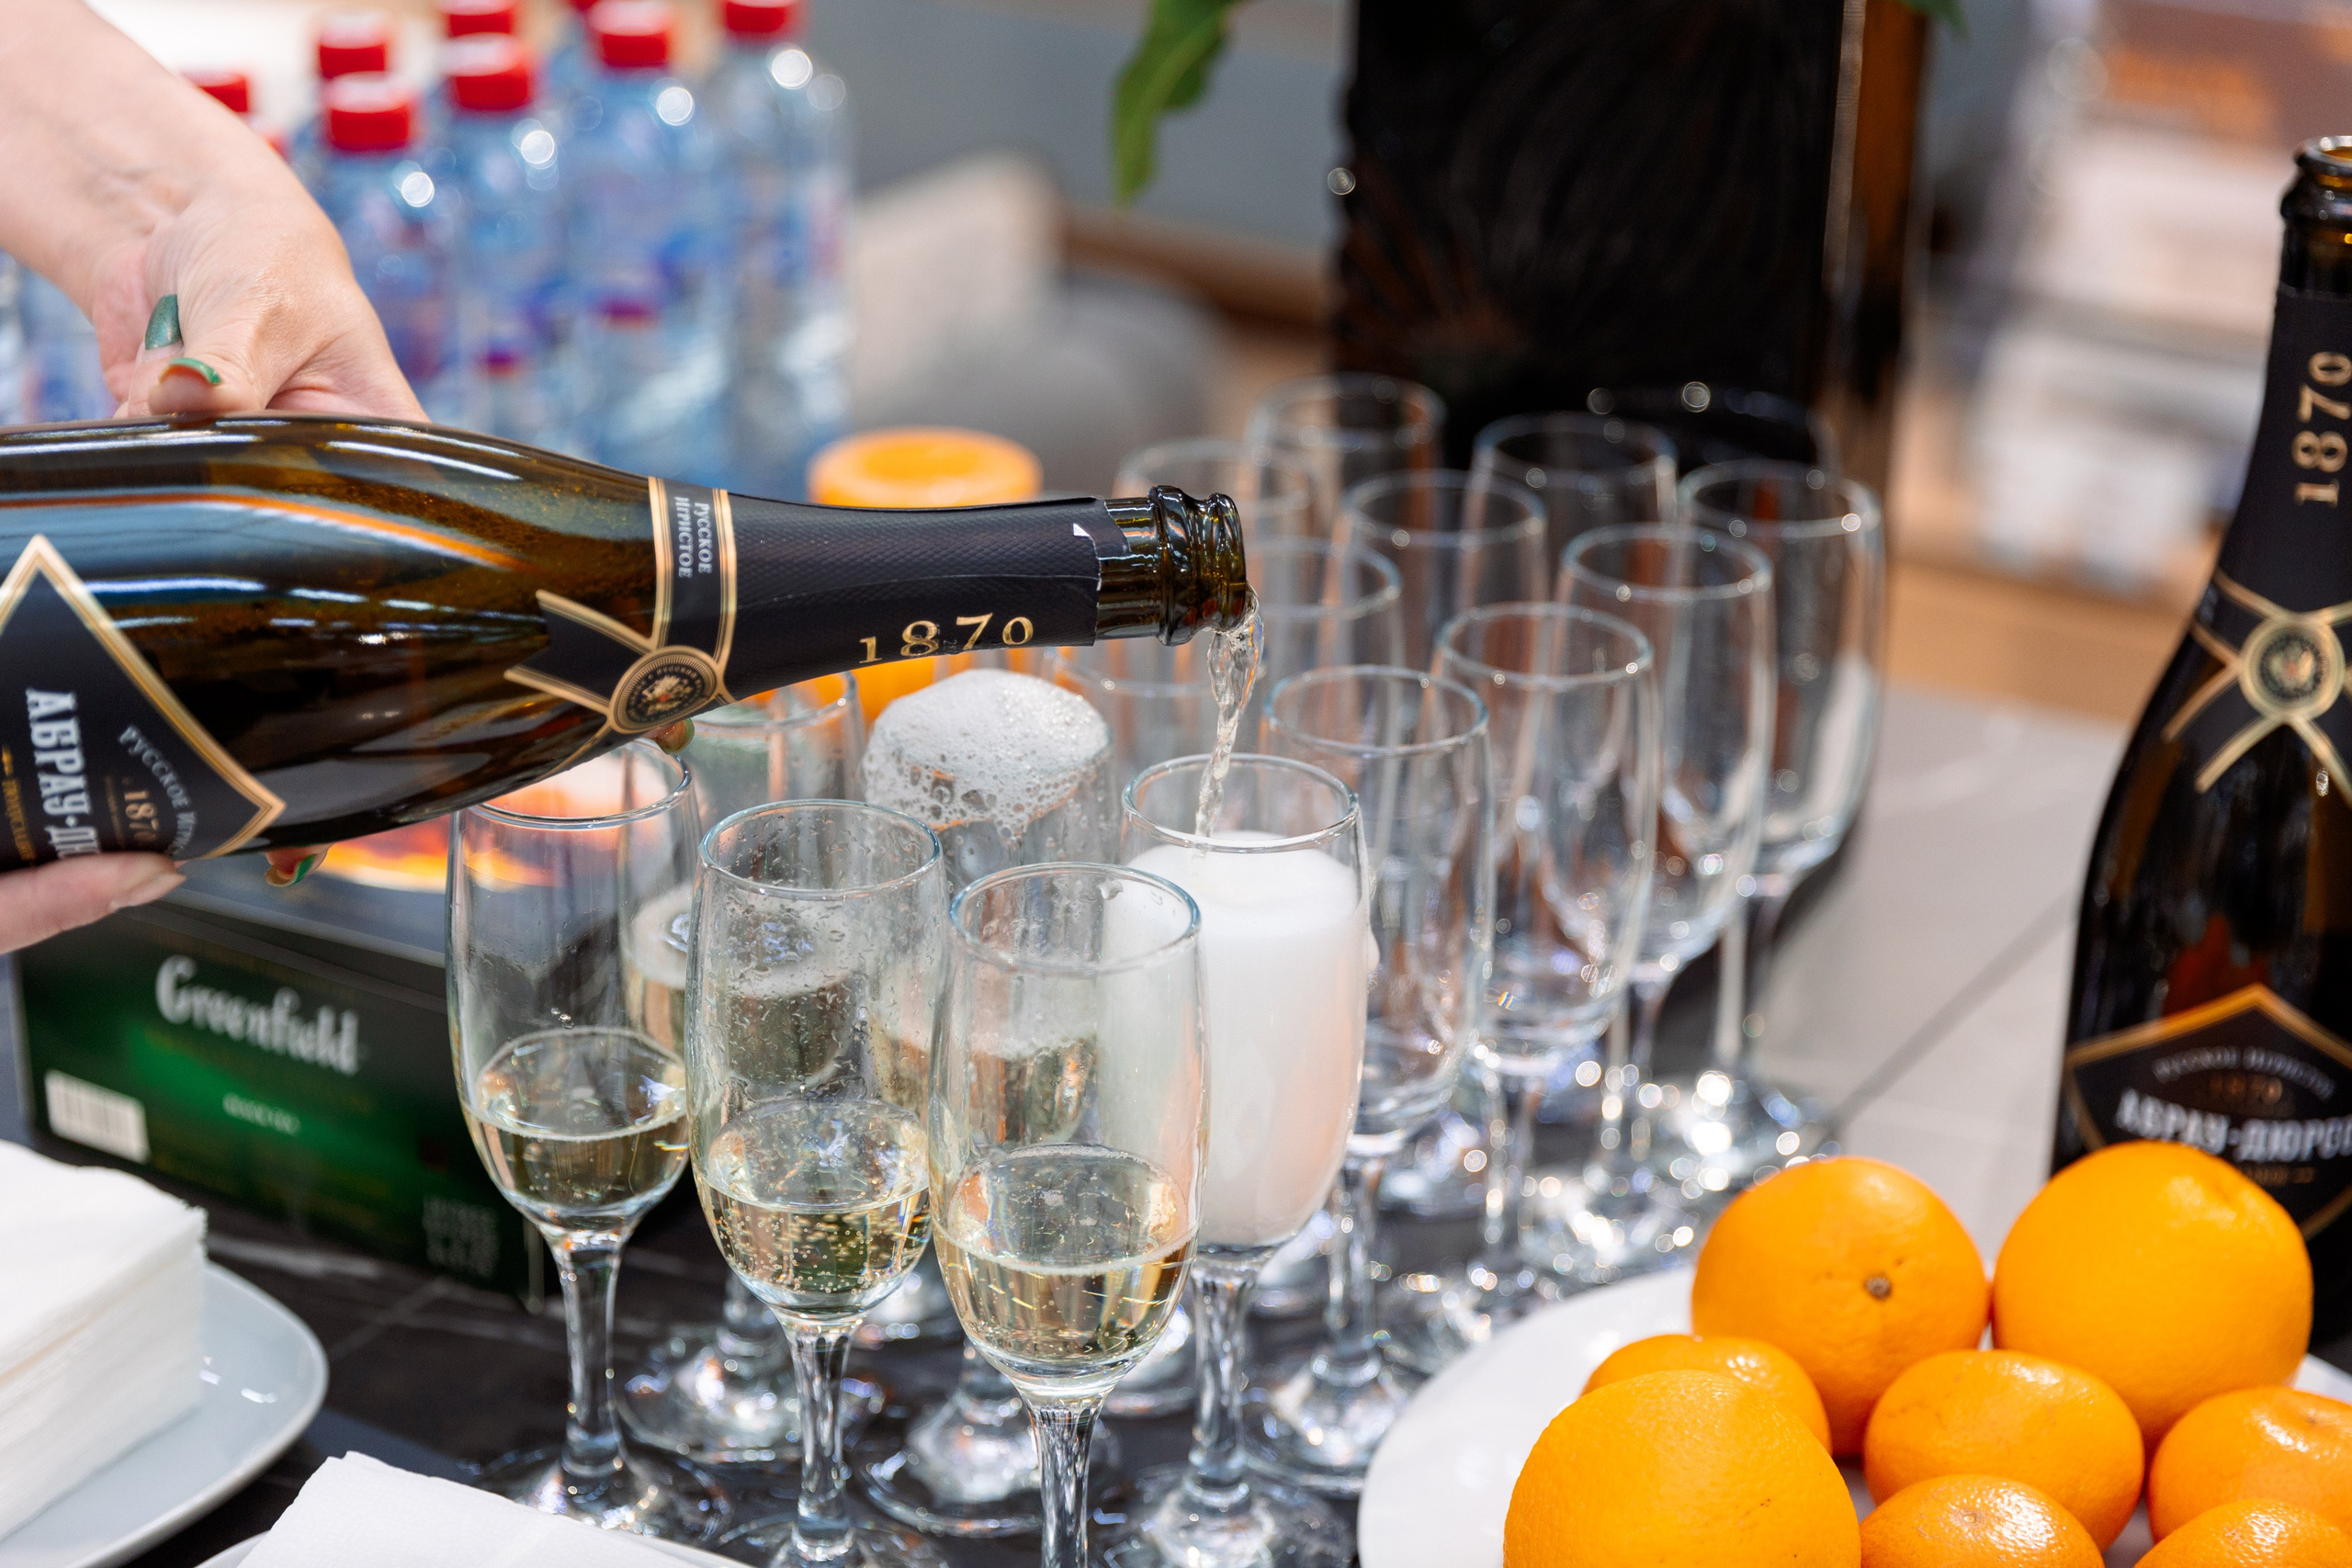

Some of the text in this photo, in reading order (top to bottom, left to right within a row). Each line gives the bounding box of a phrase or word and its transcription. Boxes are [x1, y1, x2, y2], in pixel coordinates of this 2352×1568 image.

[2291, 351, 2352, 507] 1870
[674, 496, 695, 579] ИГРИСТОЕ
[694, 502, 713, 574] РУССКОЕ
[858, 612, 1035, 664] 1870
[155, 954, 359, 1077] Greenfield
